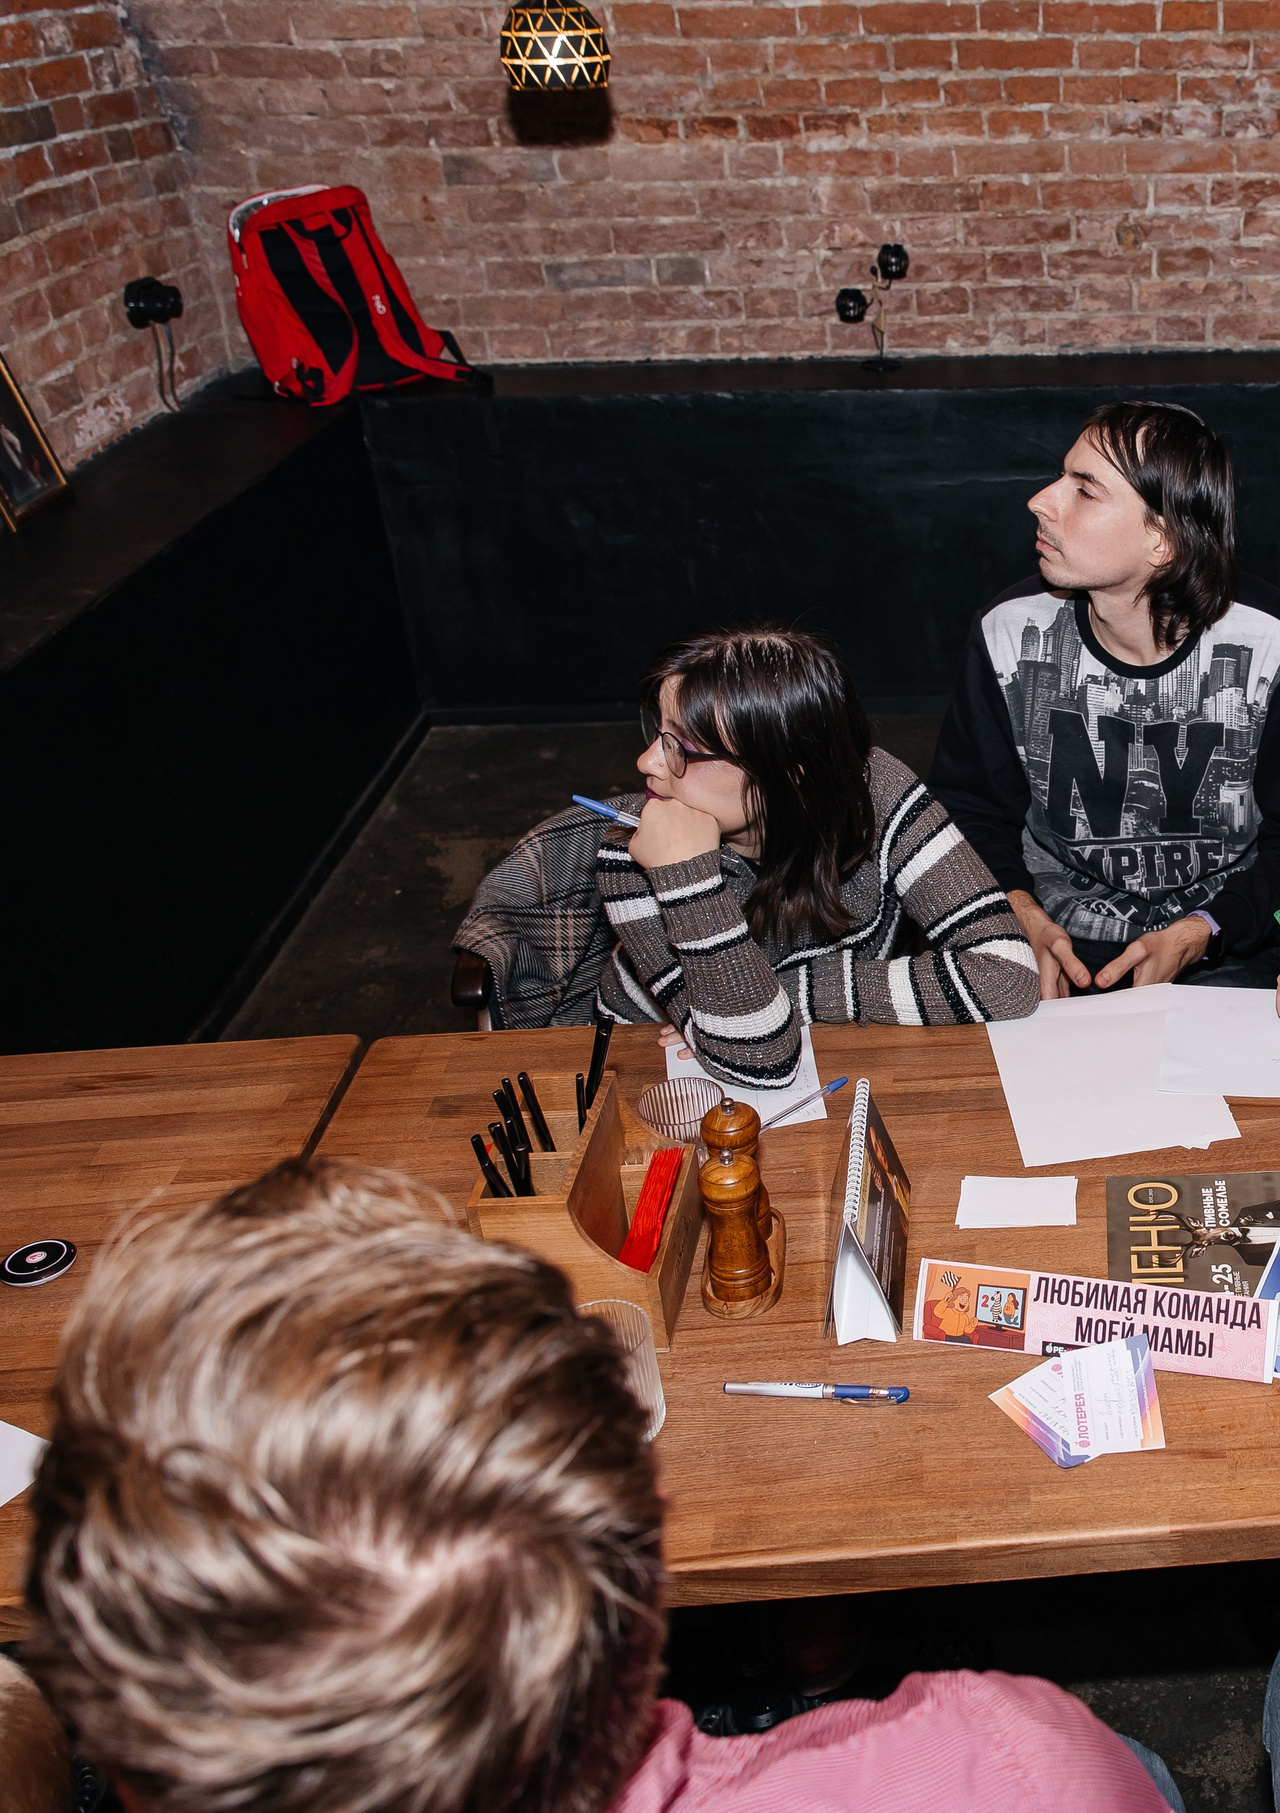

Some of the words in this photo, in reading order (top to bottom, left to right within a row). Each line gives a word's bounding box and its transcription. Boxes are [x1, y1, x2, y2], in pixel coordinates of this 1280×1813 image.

[1044, 707, 1225, 842] NY
[1201, 1187, 1218, 1229] ПИВНЫЕ
[1214, 1179, 1231, 1228] СОМЕЛЬЕ
[1127, 1182, 1184, 1284] ЕНЮ
[1033, 1276, 1147, 1316] ЛЮБИМАЯ
[1152, 1290, 1262, 1331] КОМАНДА
[1074, 1315, 1135, 1345] МОЕЙ
[1142, 1324, 1215, 1359] МАМЫ
[1074, 1393, 1091, 1440] ЛОТЕРЕЯ
